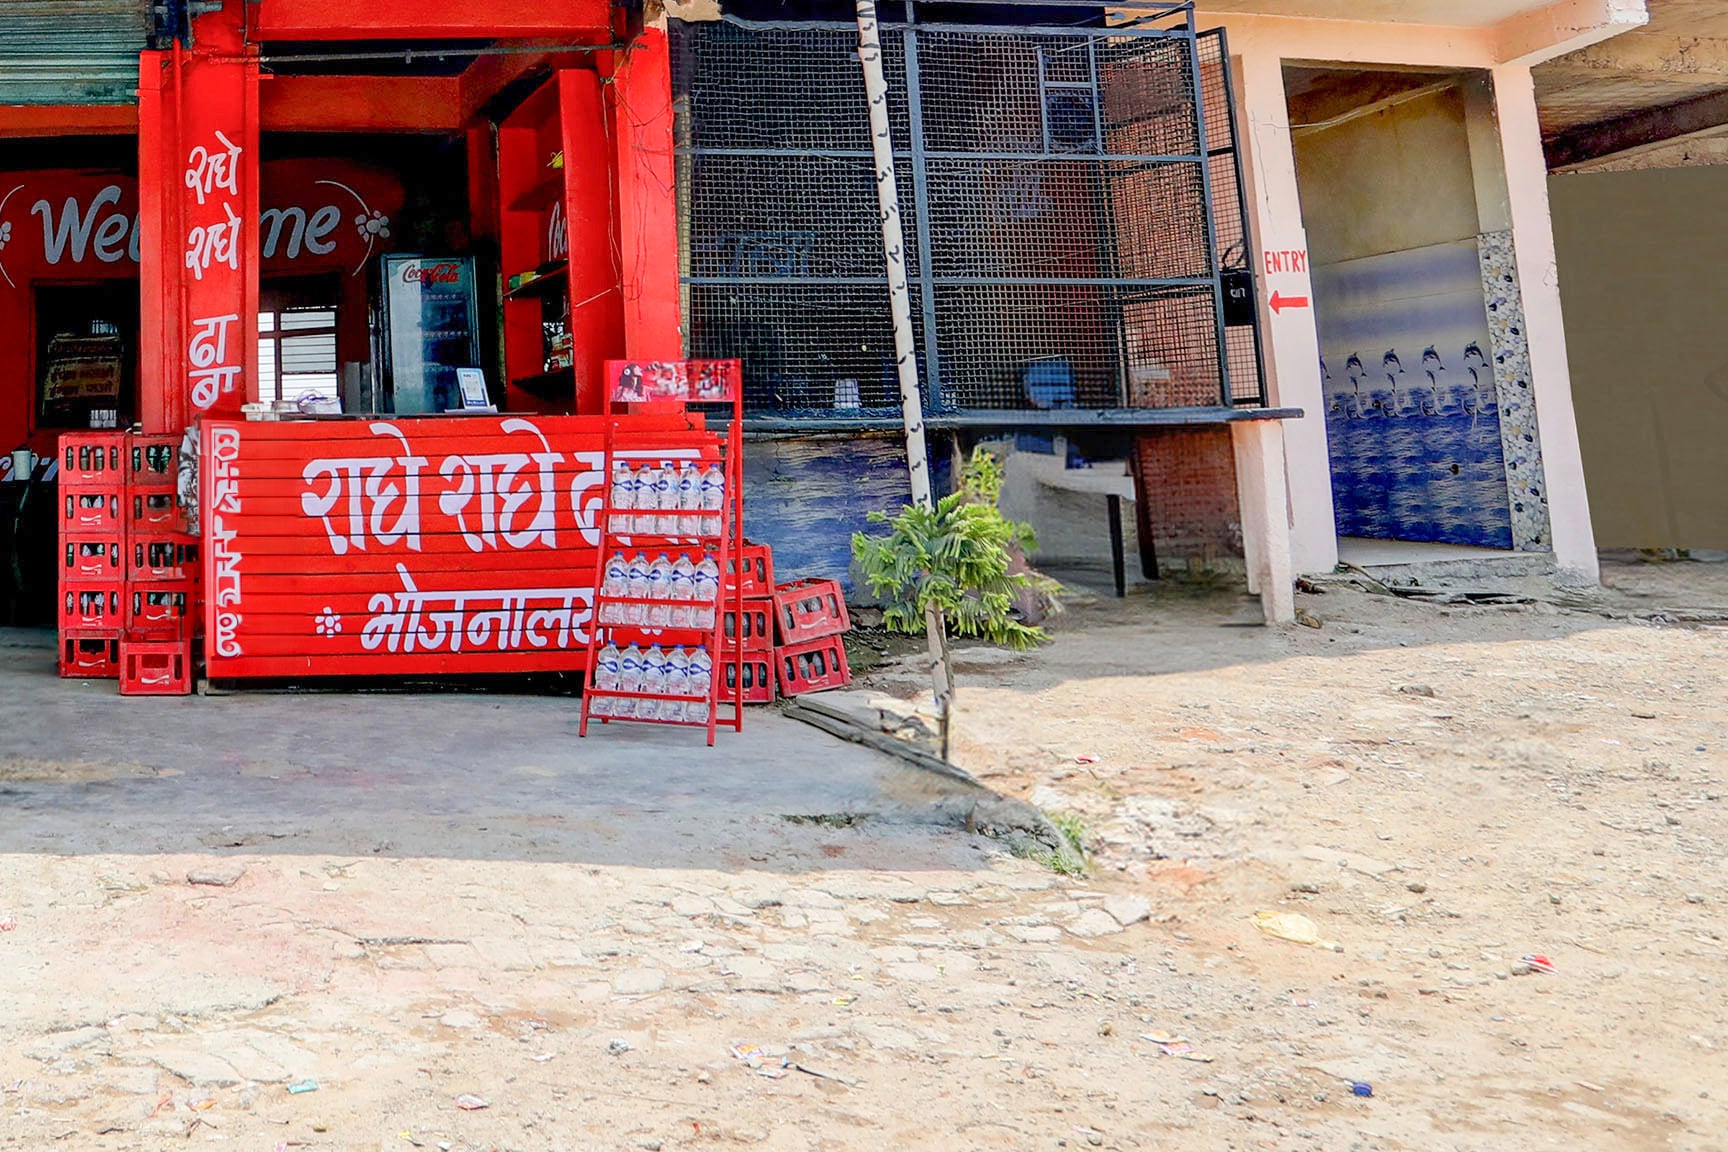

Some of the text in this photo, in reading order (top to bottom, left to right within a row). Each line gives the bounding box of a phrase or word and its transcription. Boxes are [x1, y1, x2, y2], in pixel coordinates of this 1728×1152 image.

[1264, 250, 1306, 274] ENTRY
[300, 422, 429, 555] राधे
[438, 418, 564, 553] राधे
